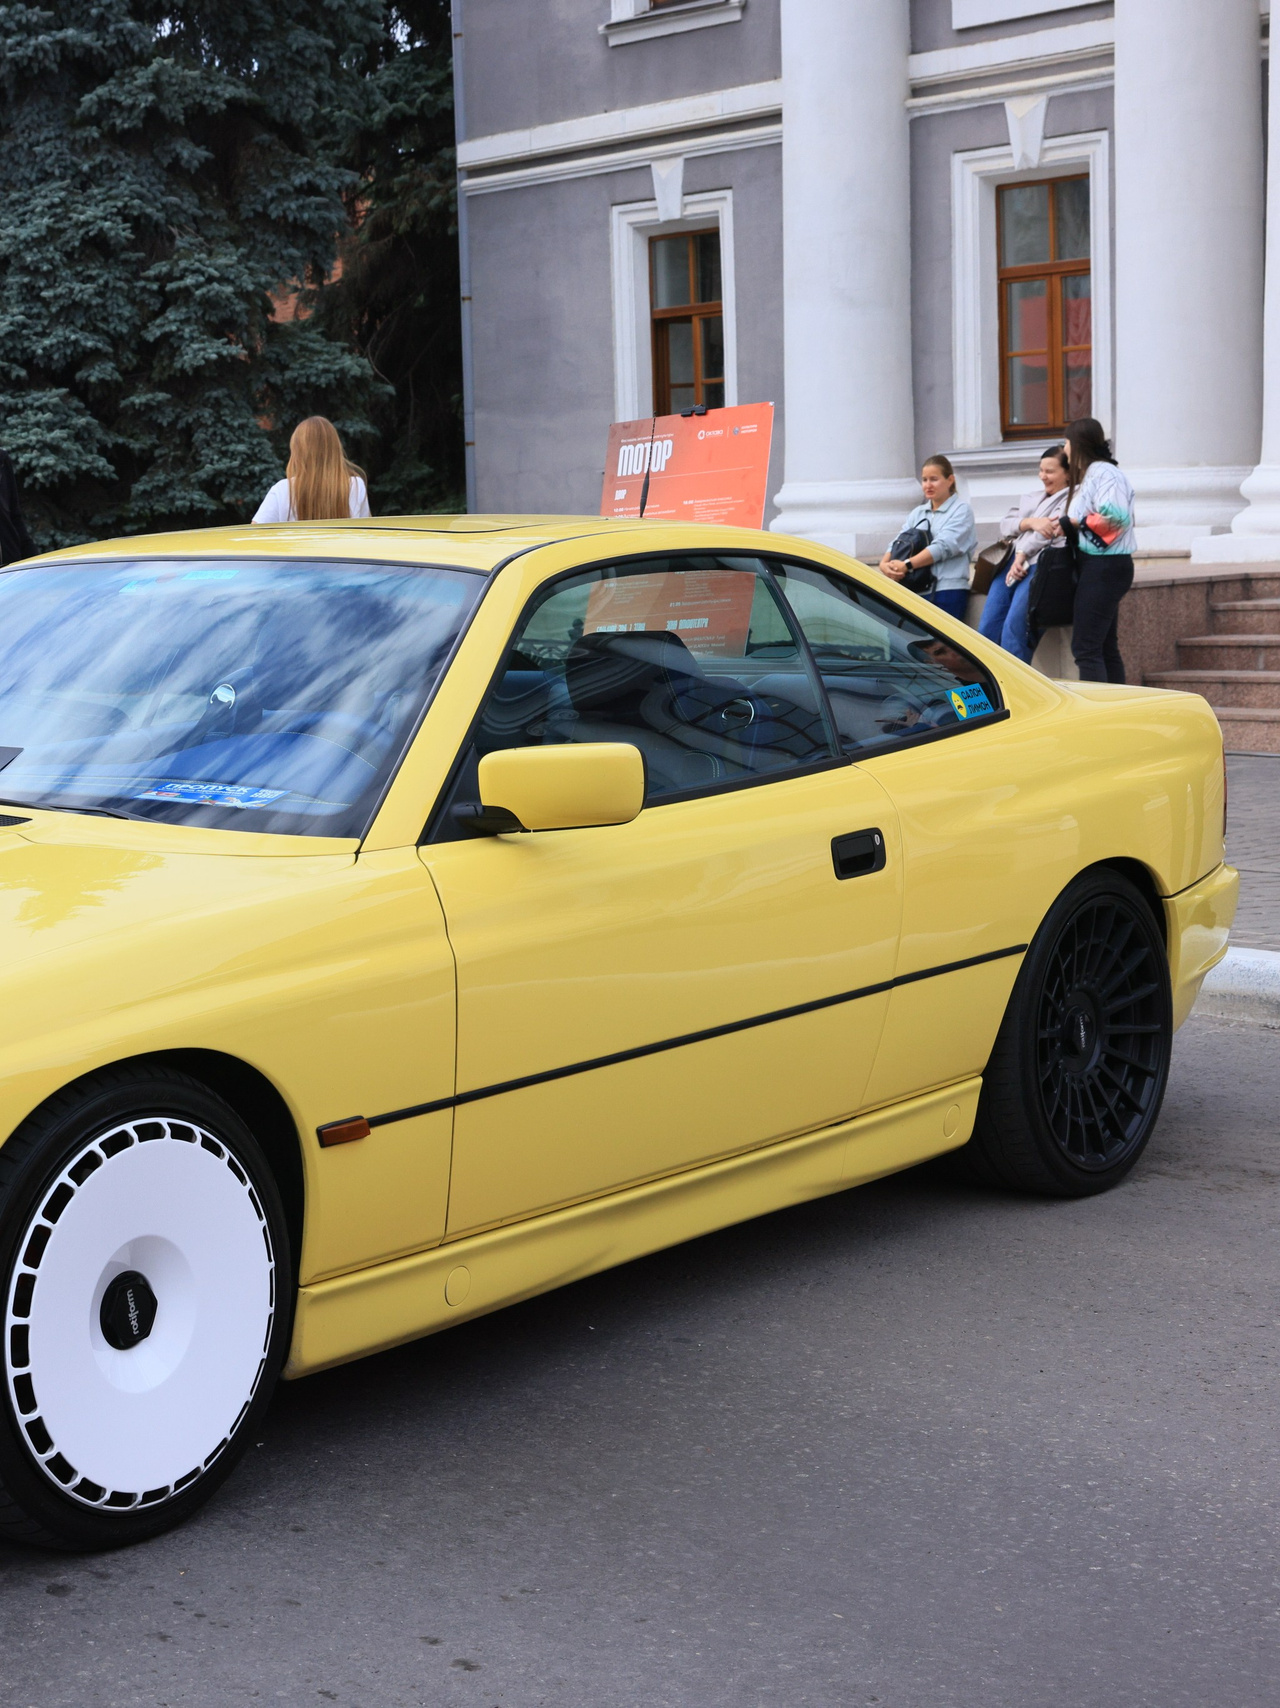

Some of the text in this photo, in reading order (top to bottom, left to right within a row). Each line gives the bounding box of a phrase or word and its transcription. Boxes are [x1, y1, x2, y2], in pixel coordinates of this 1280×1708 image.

[617, 439, 673, 477] МОТОР
[960, 686, 984, 700] САЛОН
[163, 782, 251, 793] ПРОПУСК
[127, 1289, 140, 1335] rotiform
